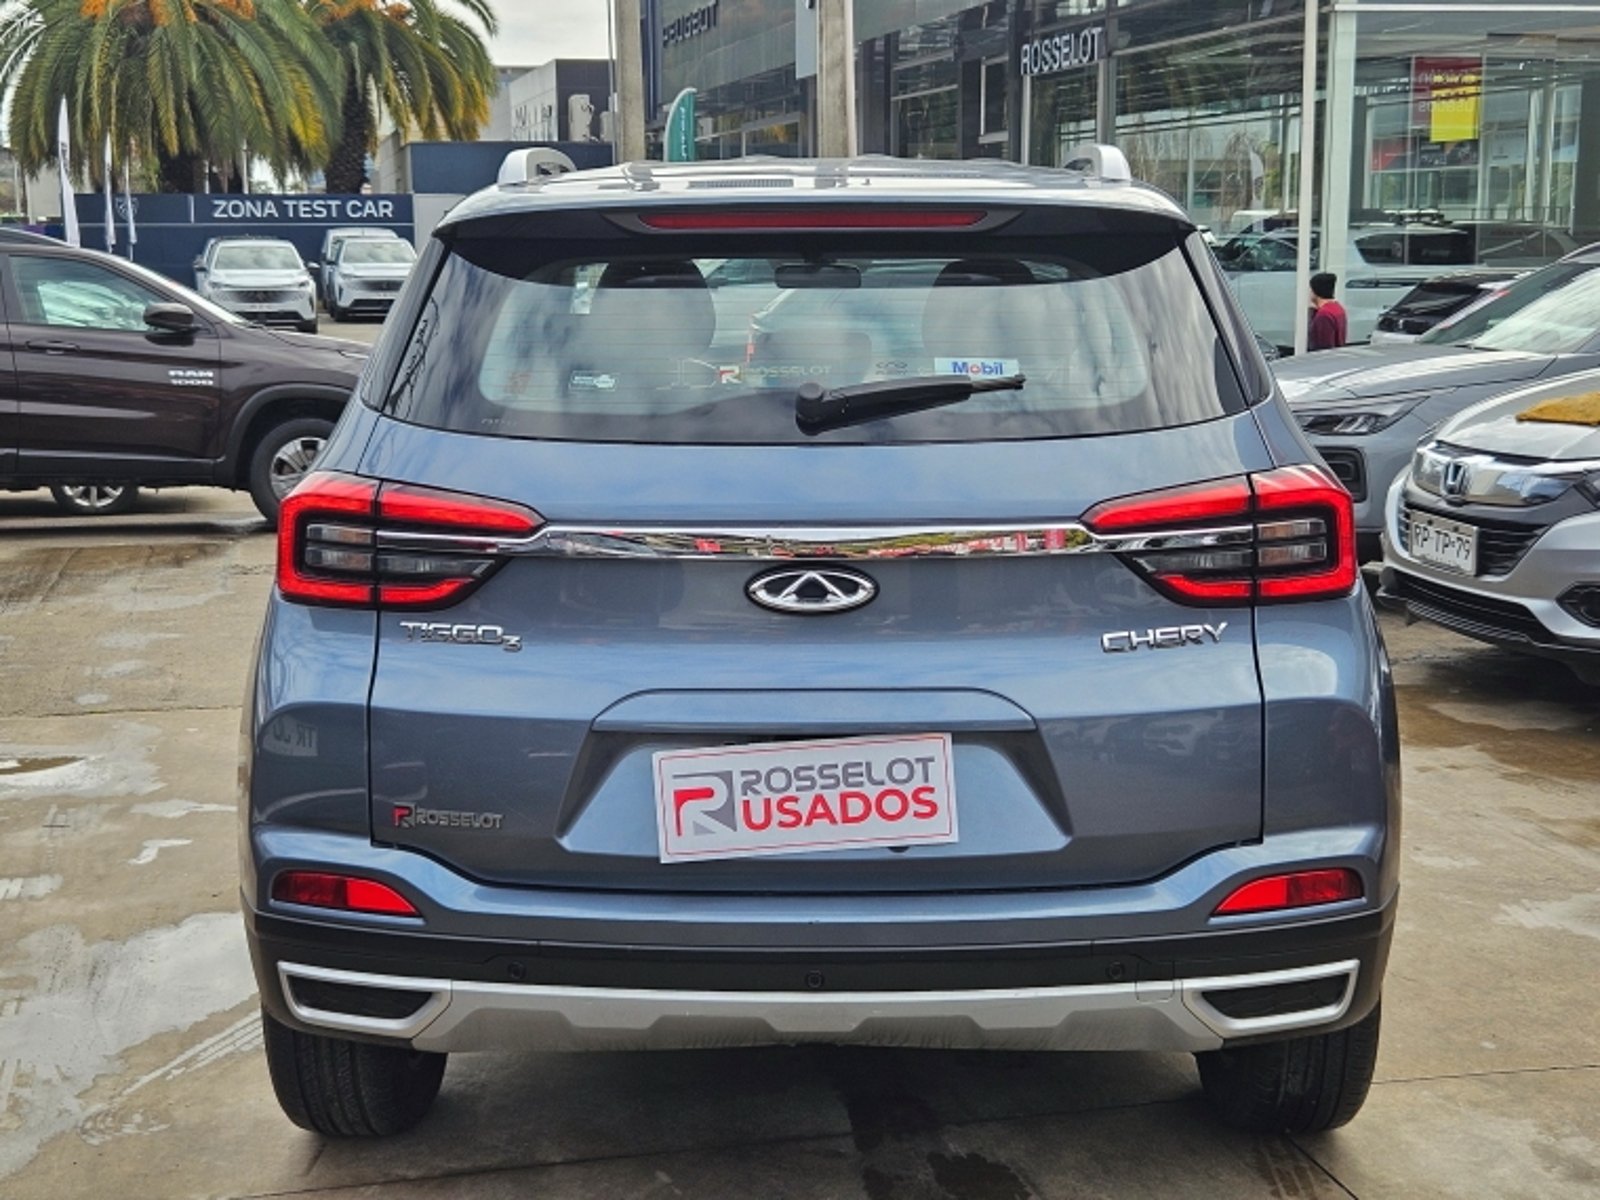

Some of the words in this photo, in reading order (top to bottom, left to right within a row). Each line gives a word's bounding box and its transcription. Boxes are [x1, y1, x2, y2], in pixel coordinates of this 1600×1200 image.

[662, 0, 719, 48] PEUGEOT
[1020, 26, 1103, 76] ROSSELOT
[213, 200, 279, 218] ZONA
[283, 200, 342, 218] TEST
[346, 200, 394, 218] CAR
[951, 361, 1004, 375] Mobil
[1101, 621, 1229, 653] CHERY
[739, 756, 936, 796] ROSSELOT
[416, 808, 504, 829] ROSSELOT
[741, 786, 940, 832] USADOS
